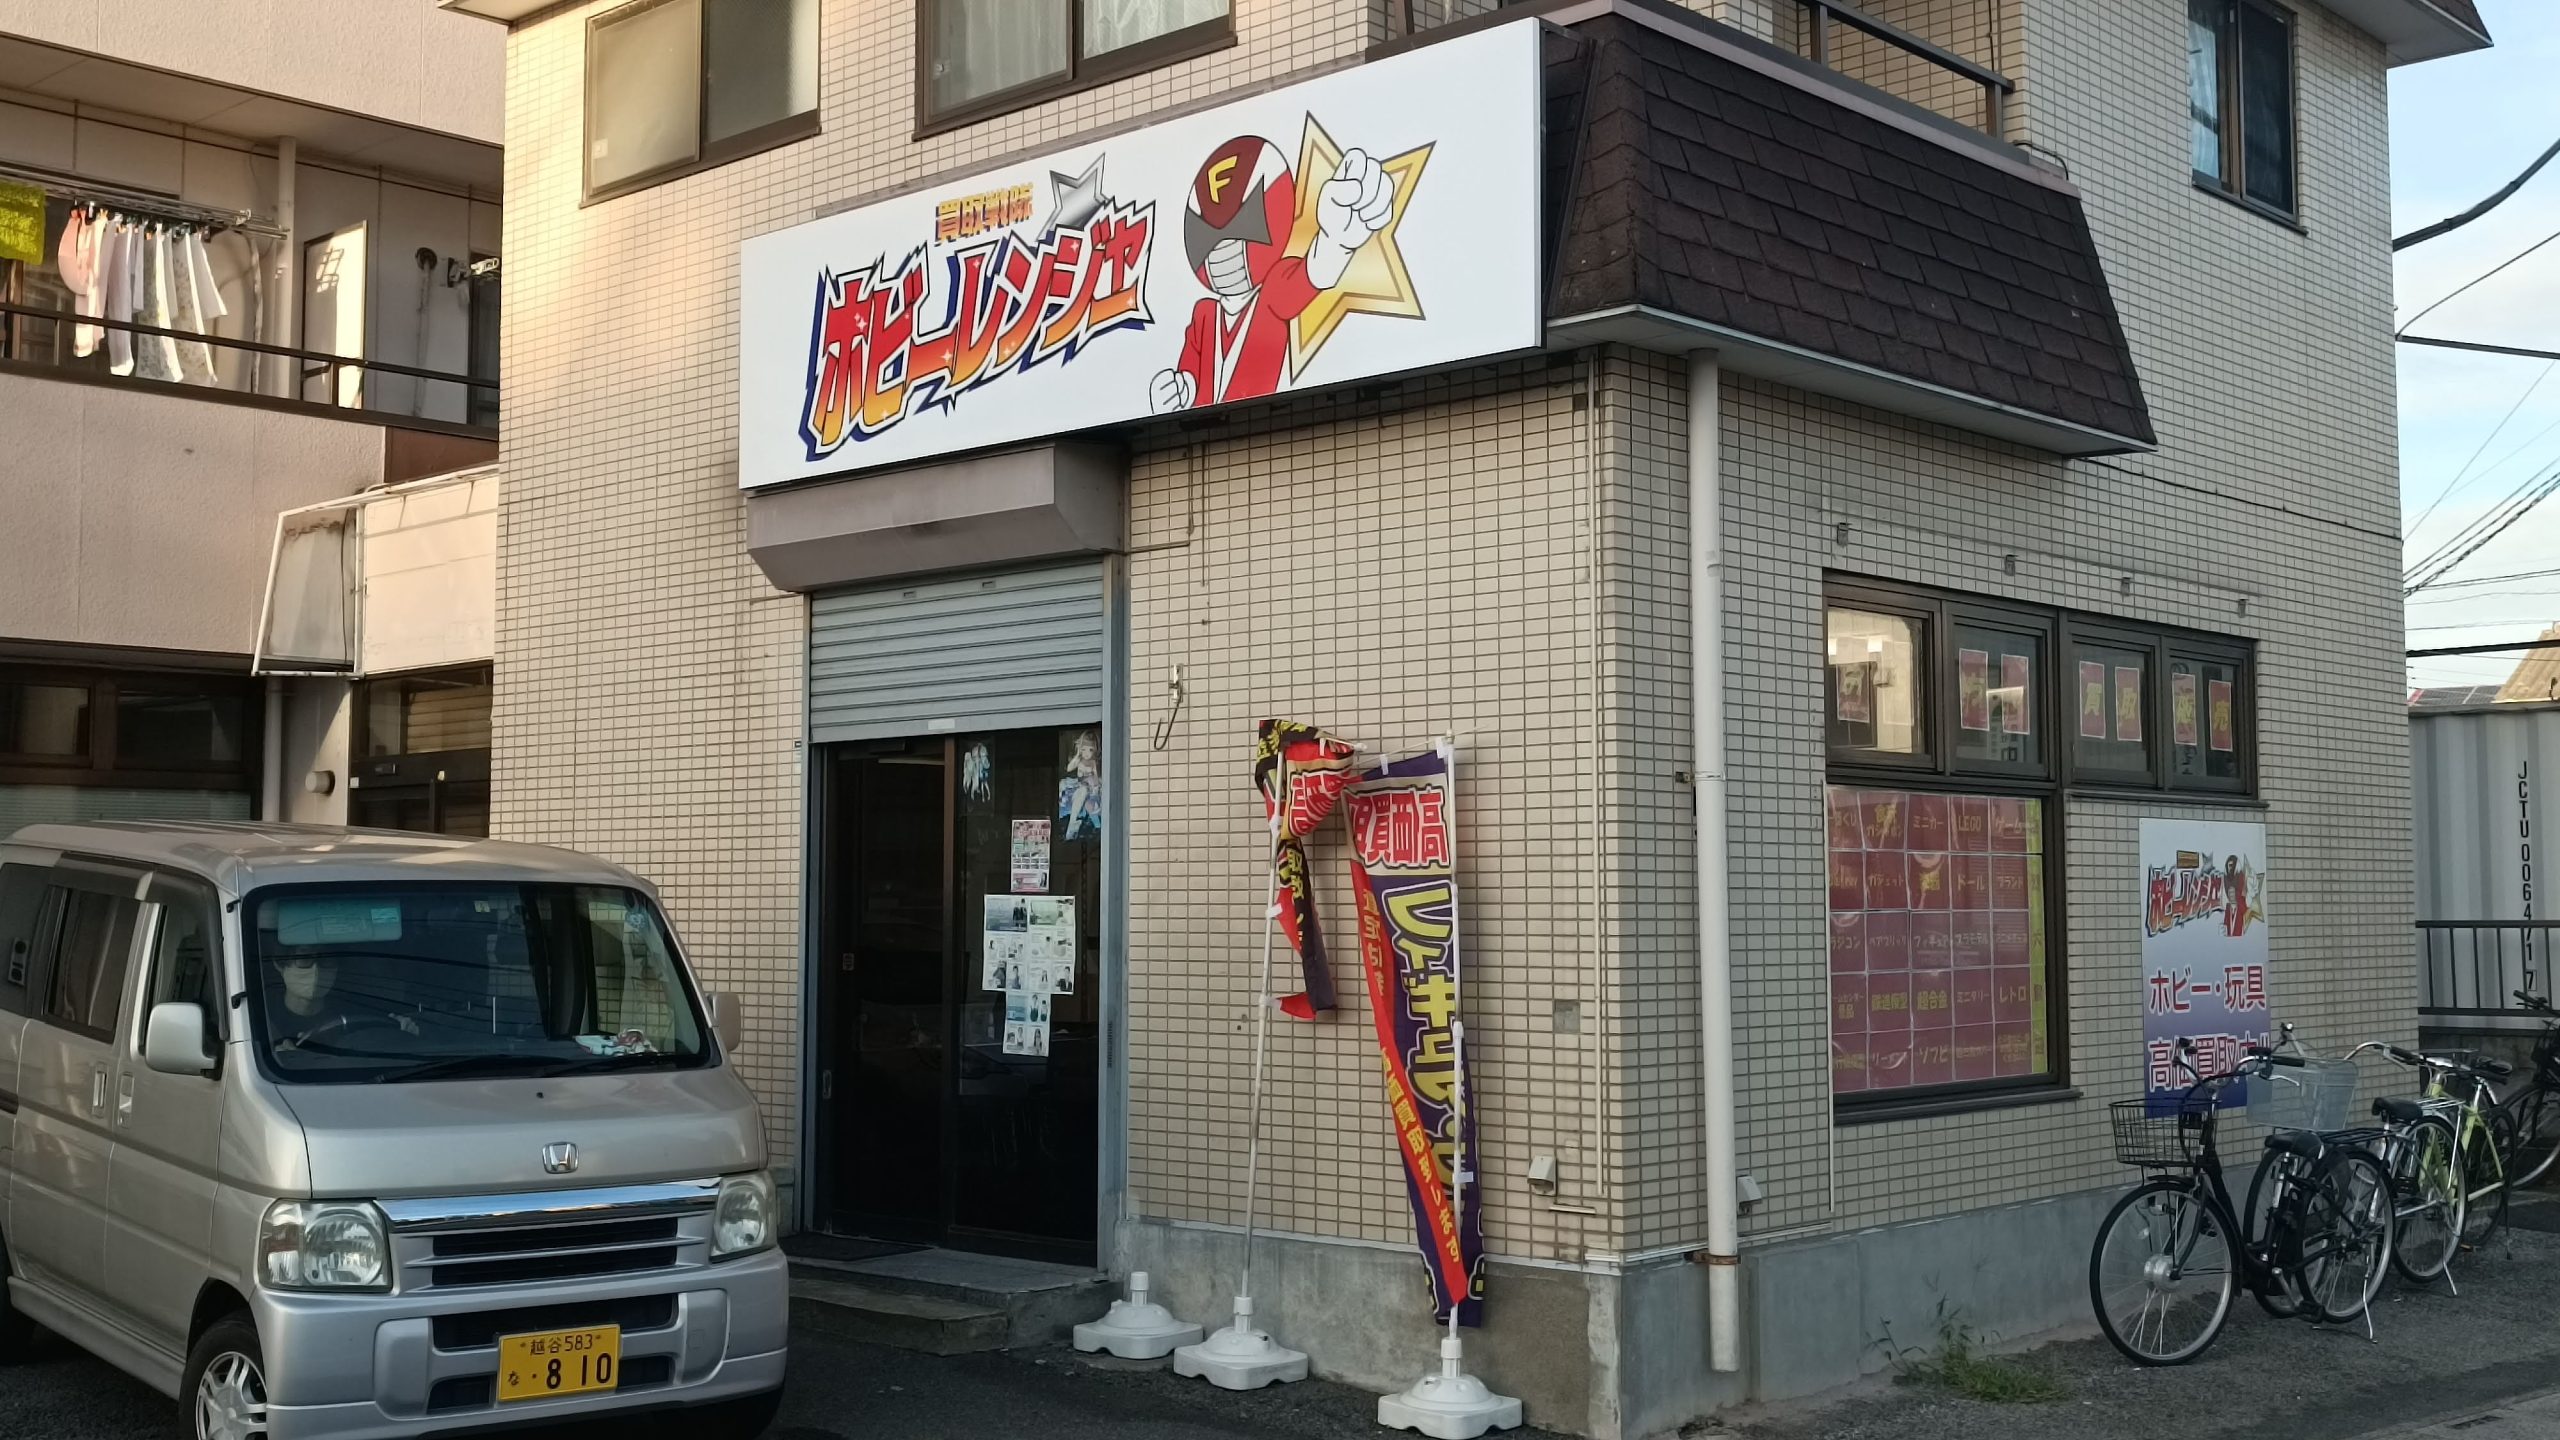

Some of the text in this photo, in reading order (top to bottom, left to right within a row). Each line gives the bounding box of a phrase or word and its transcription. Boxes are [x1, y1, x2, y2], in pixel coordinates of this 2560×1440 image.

[1207, 154, 1239, 205] F
[936, 182, 1034, 246] 買取戦隊
[2517, 760, 2530, 838] JCTU
[1957, 815, 1982, 832] LEGO
[1956, 874, 1985, 892] ドール
[1998, 985, 2028, 1004] レトロ
[2148, 963, 2267, 1017] ホビー・玩具
[1918, 1046, 1949, 1065] ソフビ
